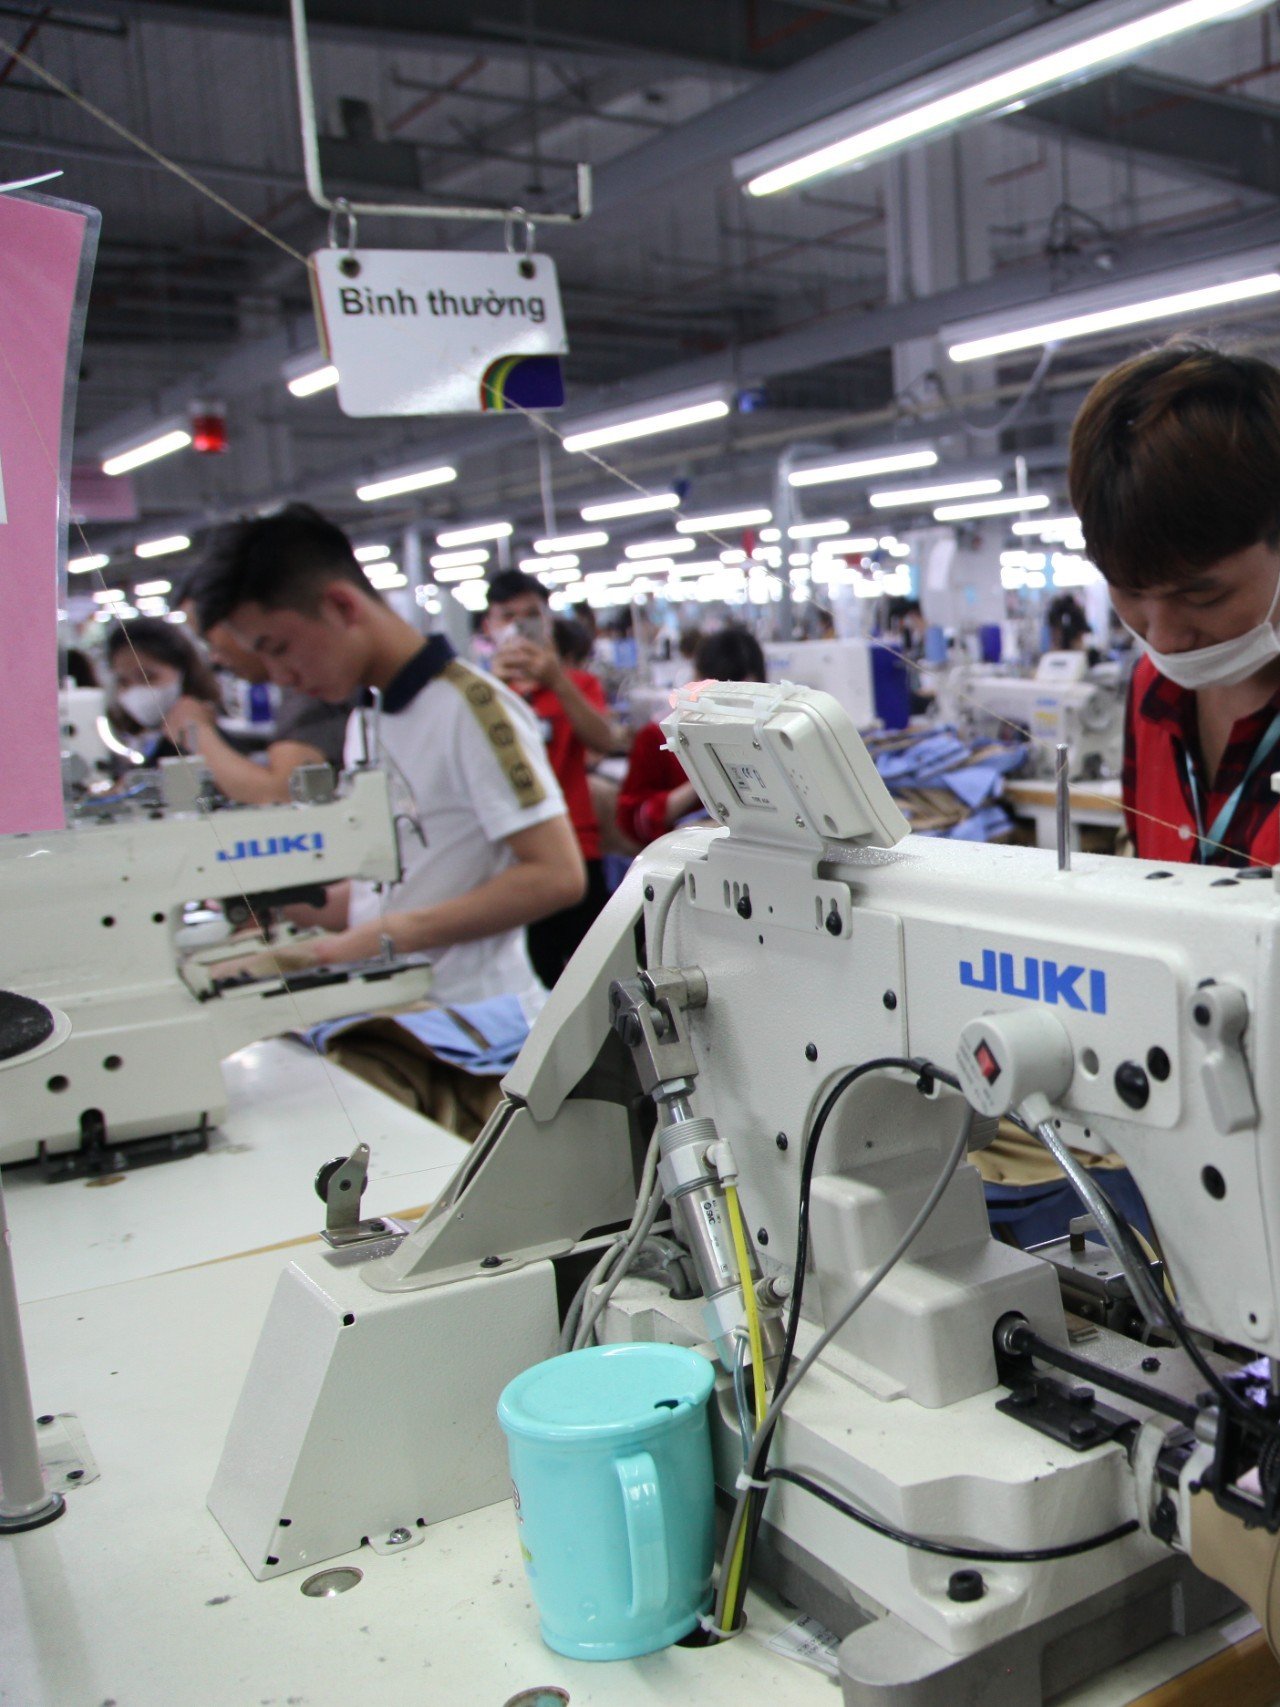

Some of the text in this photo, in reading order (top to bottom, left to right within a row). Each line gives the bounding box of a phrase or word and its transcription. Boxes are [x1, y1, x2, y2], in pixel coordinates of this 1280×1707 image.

[339, 287, 546, 323] Bình thường
[217, 832, 323, 861] JUKI
[959, 949, 1106, 1015] JUKI
